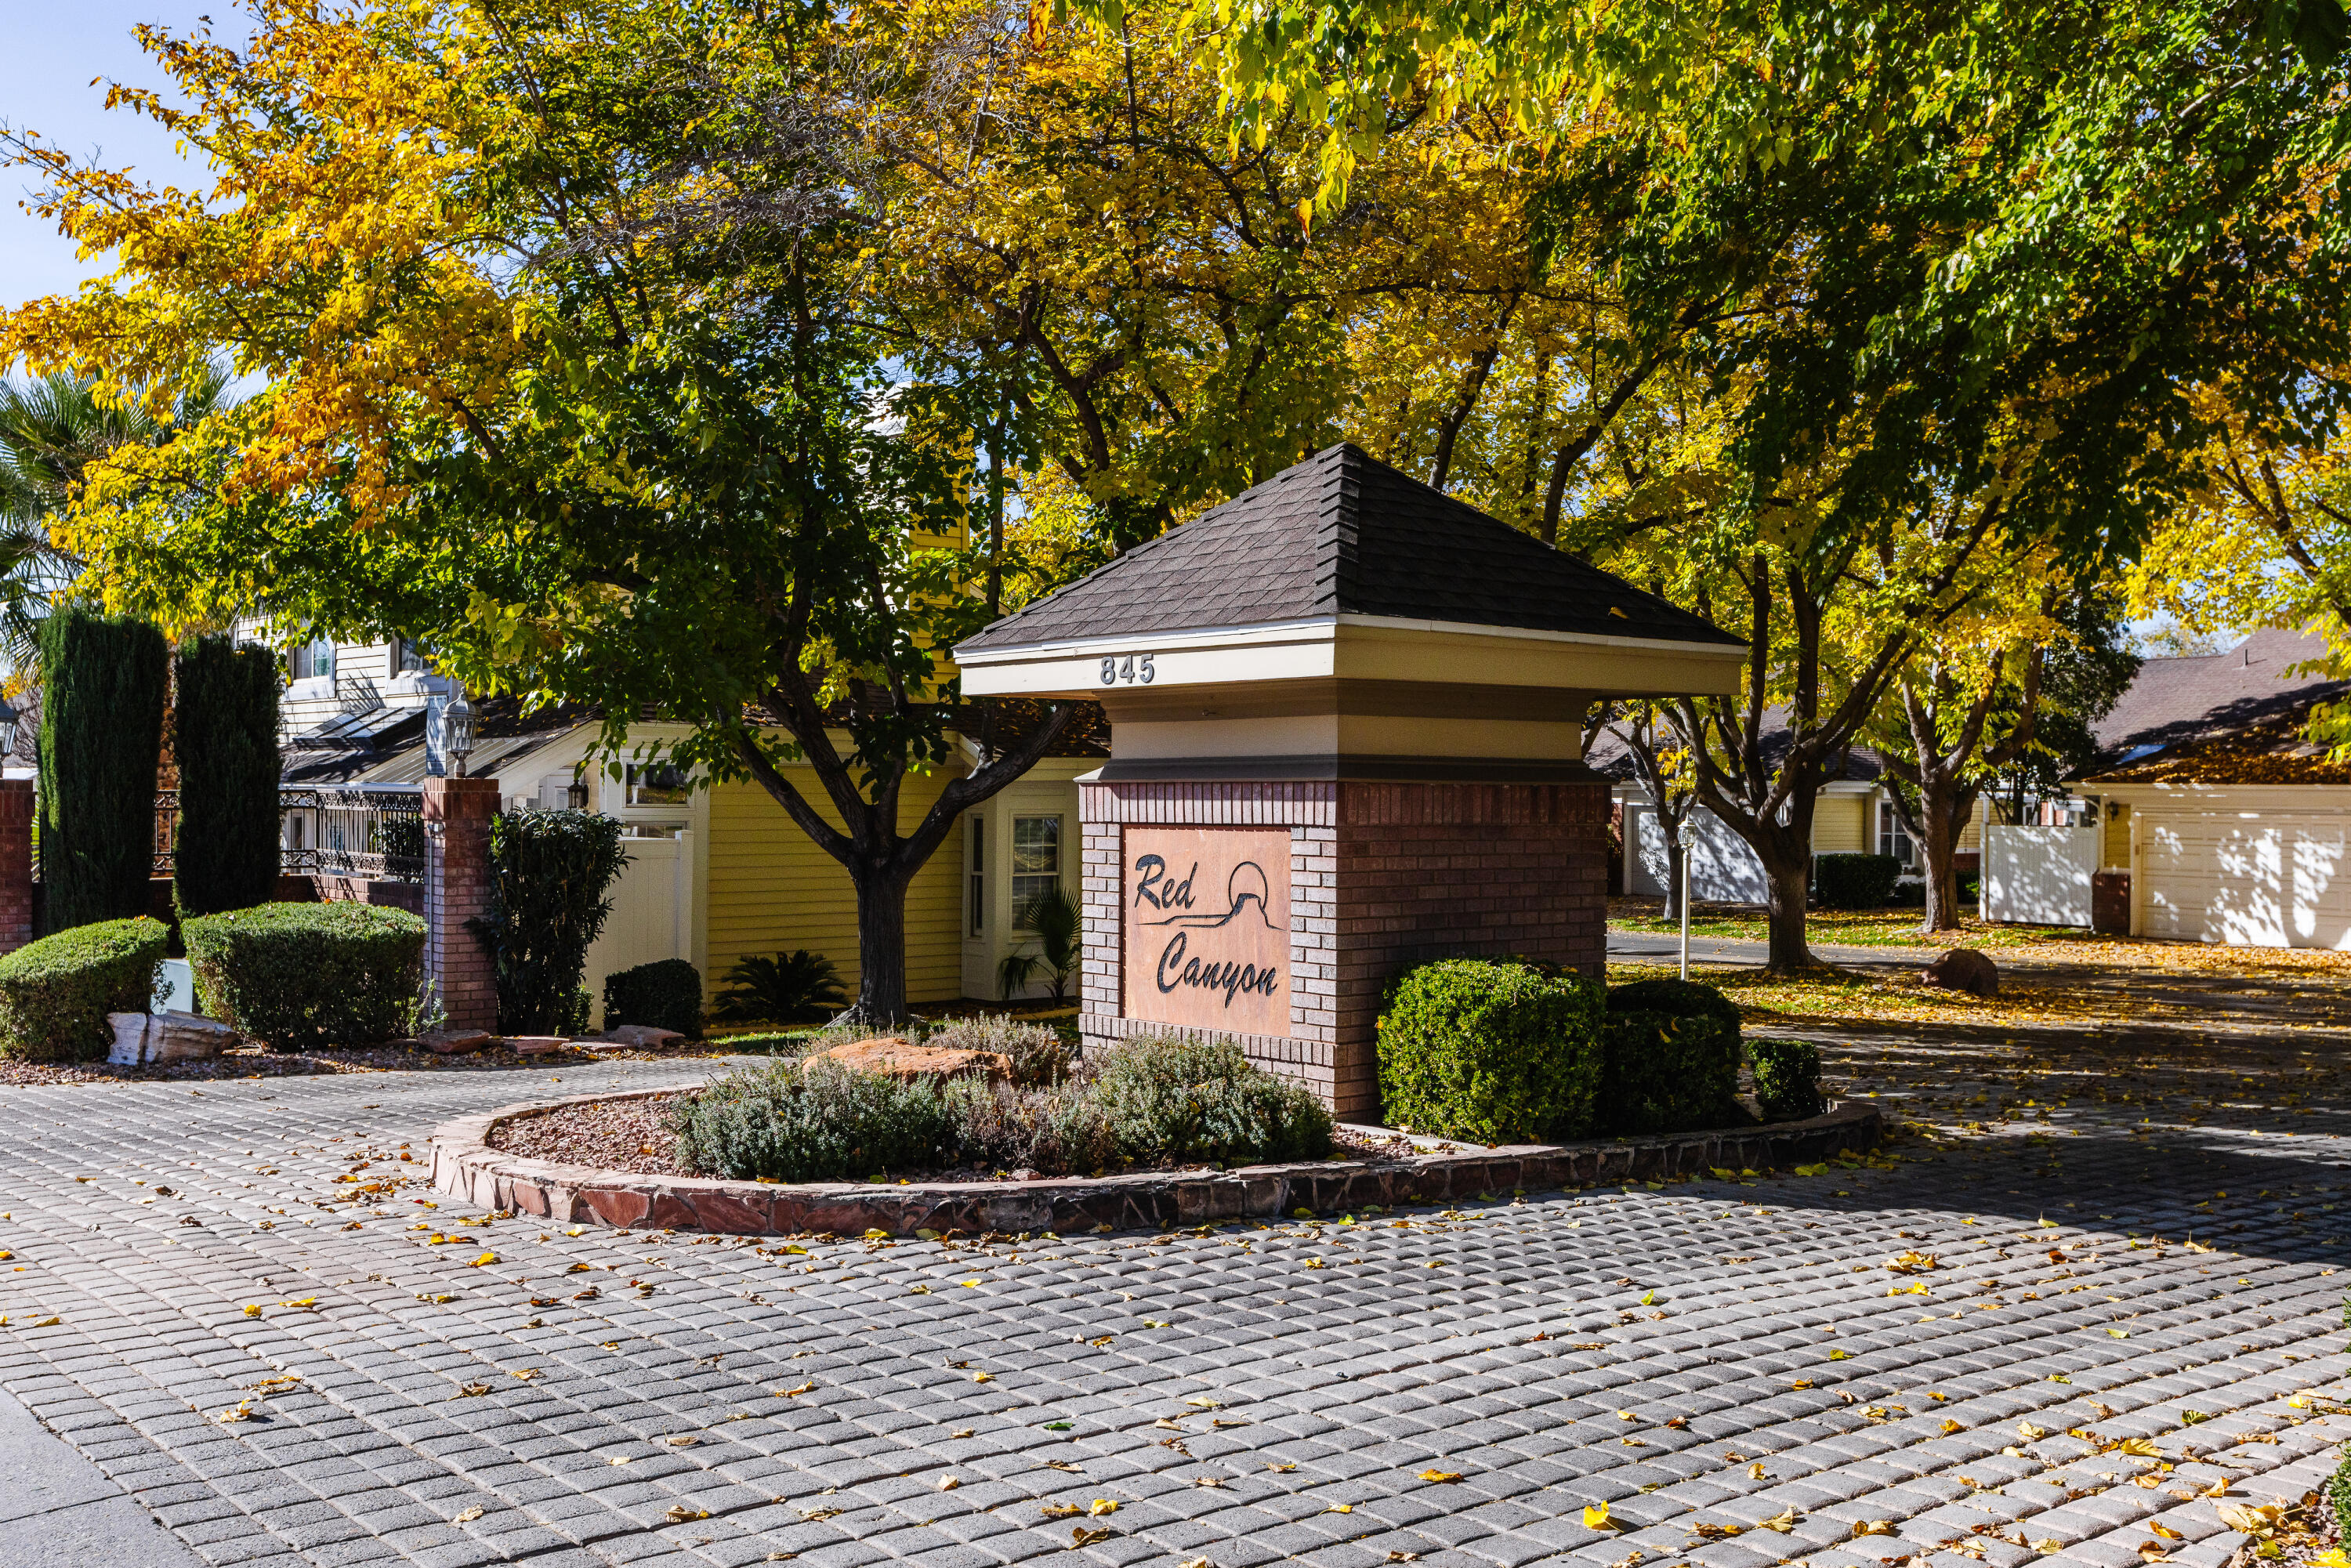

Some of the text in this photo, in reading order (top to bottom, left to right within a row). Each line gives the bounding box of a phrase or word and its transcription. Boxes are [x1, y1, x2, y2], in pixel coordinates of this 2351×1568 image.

[1100, 654, 1154, 685] 845
[1135, 854, 1197, 910] Red
[1157, 932, 1277, 1009] Canyon
